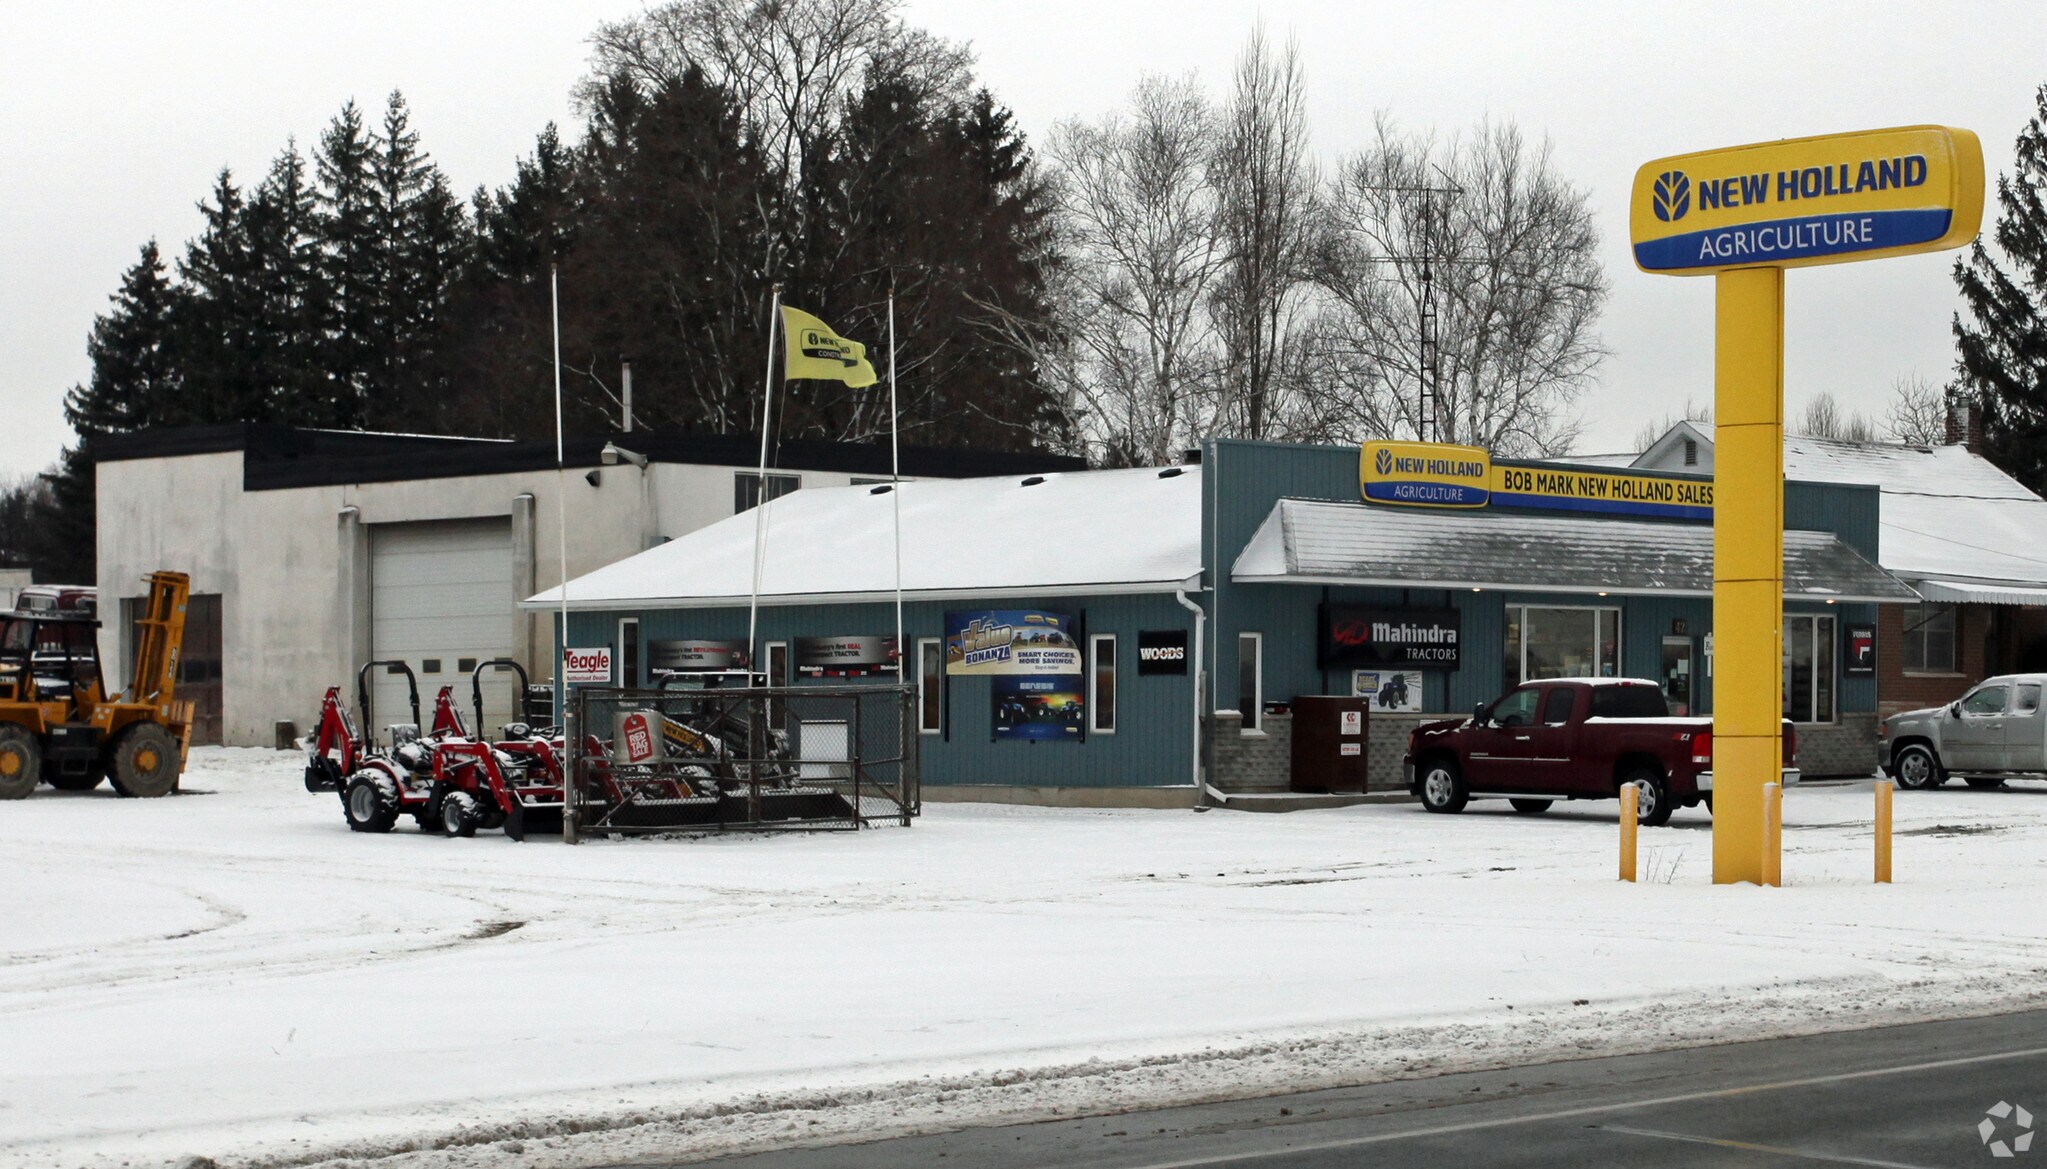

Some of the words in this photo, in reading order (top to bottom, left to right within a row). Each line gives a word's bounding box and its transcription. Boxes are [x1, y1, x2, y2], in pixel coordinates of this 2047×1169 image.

[1699, 172, 1770, 211] NEW
[1777, 154, 1927, 202] HOLLAND
[1699, 218, 1873, 260] AGRICULTURE
[1395, 457, 1424, 474] NEW
[1427, 459, 1483, 477] HOLLAND
[1394, 485, 1463, 501] AGRICULTURE
[1505, 470, 1532, 491] BOB
[1537, 473, 1574, 495] MARK
[1578, 476, 1608, 497] NEW
[1612, 479, 1673, 501] HOLLAND
[1677, 483, 1714, 505] SALES
[962, 620, 1012, 653] Value
[1372, 622, 1457, 643] Mahindra
[566, 650, 609, 673] Teagle
[966, 646, 1011, 665] BONANZA
[1140, 647, 1184, 661] WOODS
[1406, 648, 1457, 660] TRACTORS
[628, 731, 646, 744] RED
[630, 739, 648, 752] TAG
